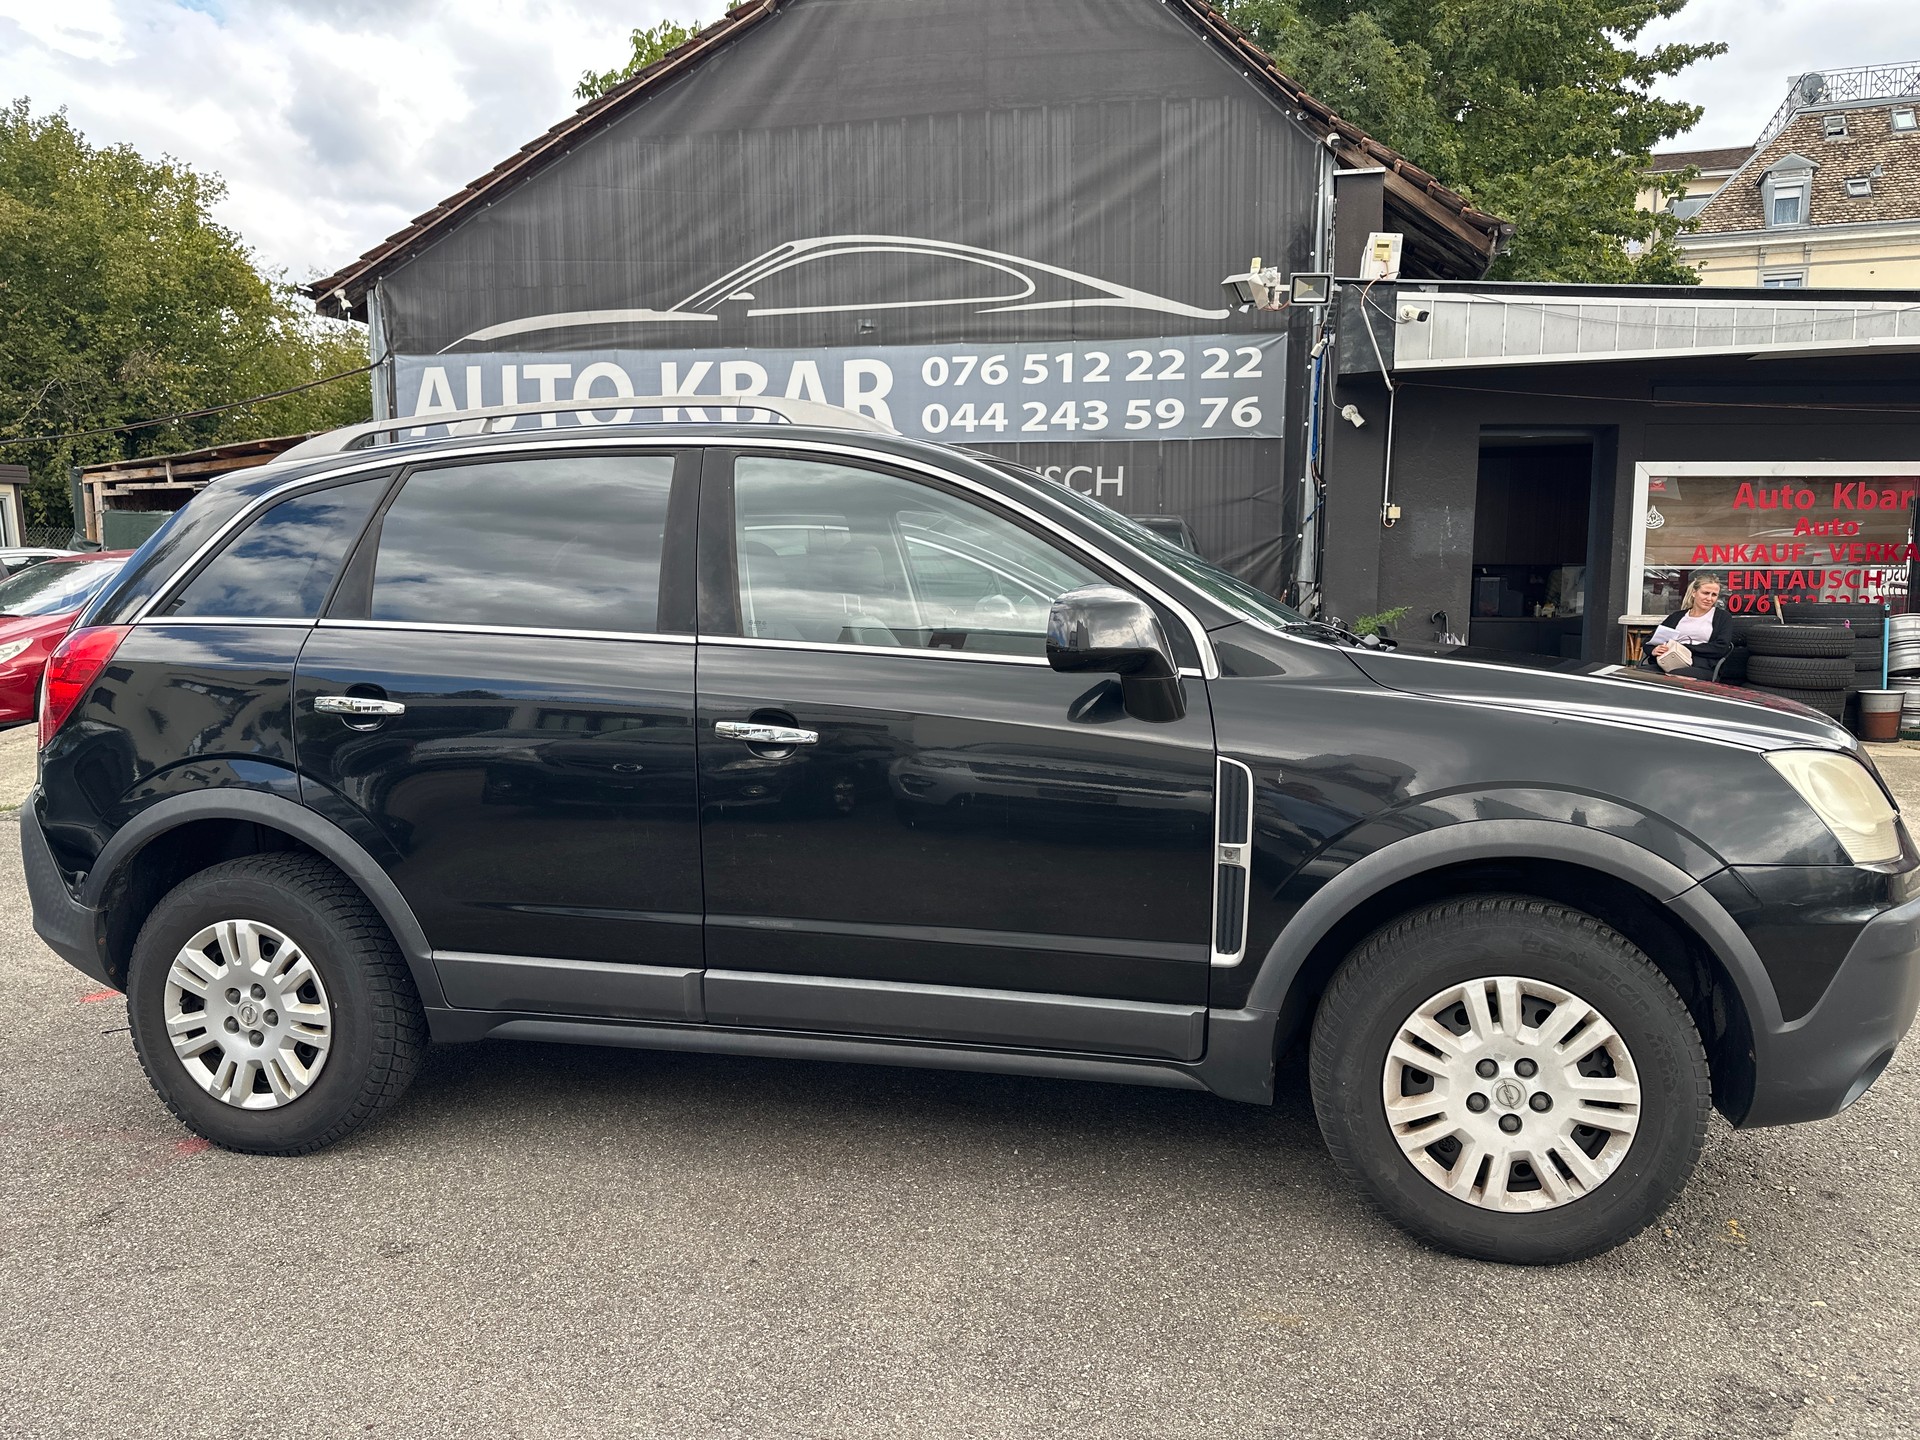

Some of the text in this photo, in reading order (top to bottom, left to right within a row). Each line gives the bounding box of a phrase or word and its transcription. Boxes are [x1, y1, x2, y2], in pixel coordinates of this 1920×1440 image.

[921, 346, 1263, 387] 076 512 22 22
[410, 359, 897, 436] AUTO KBAR
[921, 396, 1263, 434] 044 243 59 76
[1732, 481, 1914, 511] Auto Kbar
[1793, 517, 1860, 537] Auto
[1691, 543, 1806, 563] ANKAUF
[1829, 543, 1920, 562] VERKA
[1728, 570, 1882, 590] EINTAUSCH
[1728, 594, 1770, 613] 076
